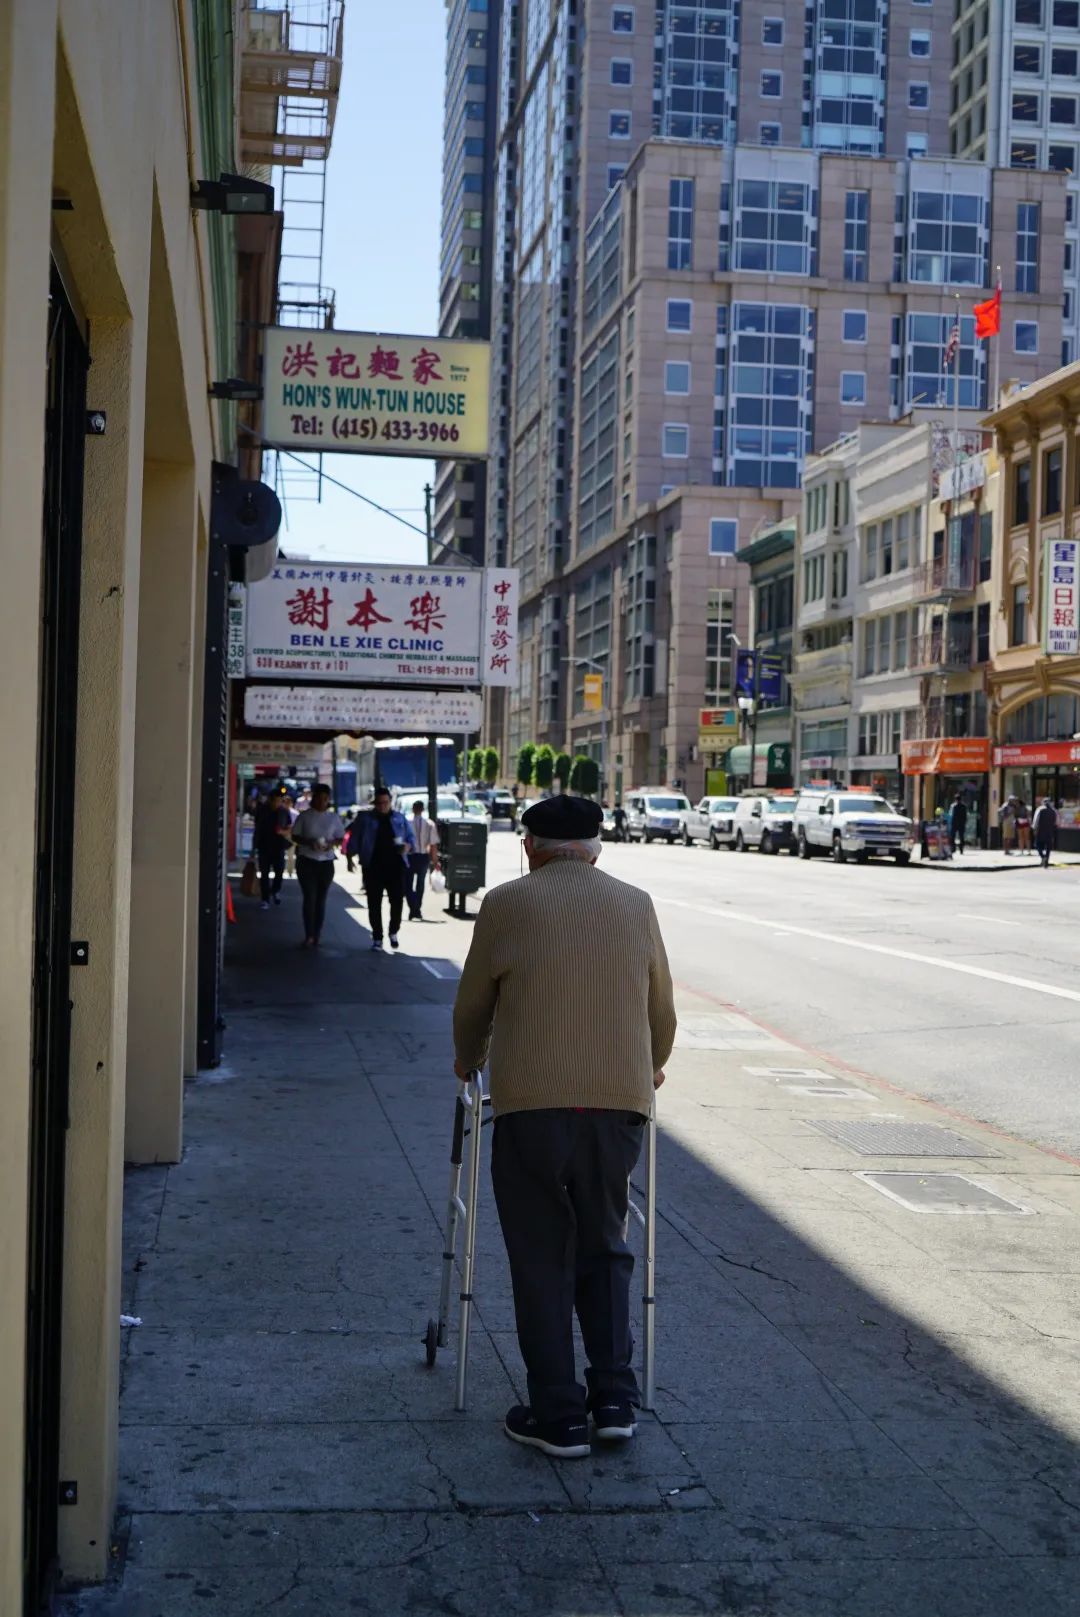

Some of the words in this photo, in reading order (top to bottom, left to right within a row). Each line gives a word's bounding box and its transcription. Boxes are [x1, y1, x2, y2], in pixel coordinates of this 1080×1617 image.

[282, 340, 444, 385] 洪記麵家
[282, 383, 331, 409] HON'S
[413, 391, 465, 416] HOUSE
[290, 414, 323, 436] Tel:
[331, 415, 378, 440] (415)
[381, 419, 459, 443] 433-3966
[1053, 543, 1075, 628] 星島日報
[489, 579, 513, 674] 中醫診所
[290, 634, 324, 647] BEN
[329, 635, 351, 648] LE
[355, 636, 384, 650] XIE
[387, 637, 445, 653] CLINIC
[273, 659, 309, 671] KEARNY
[310, 661, 324, 671] ST.
[397, 664, 415, 674] TEL:
